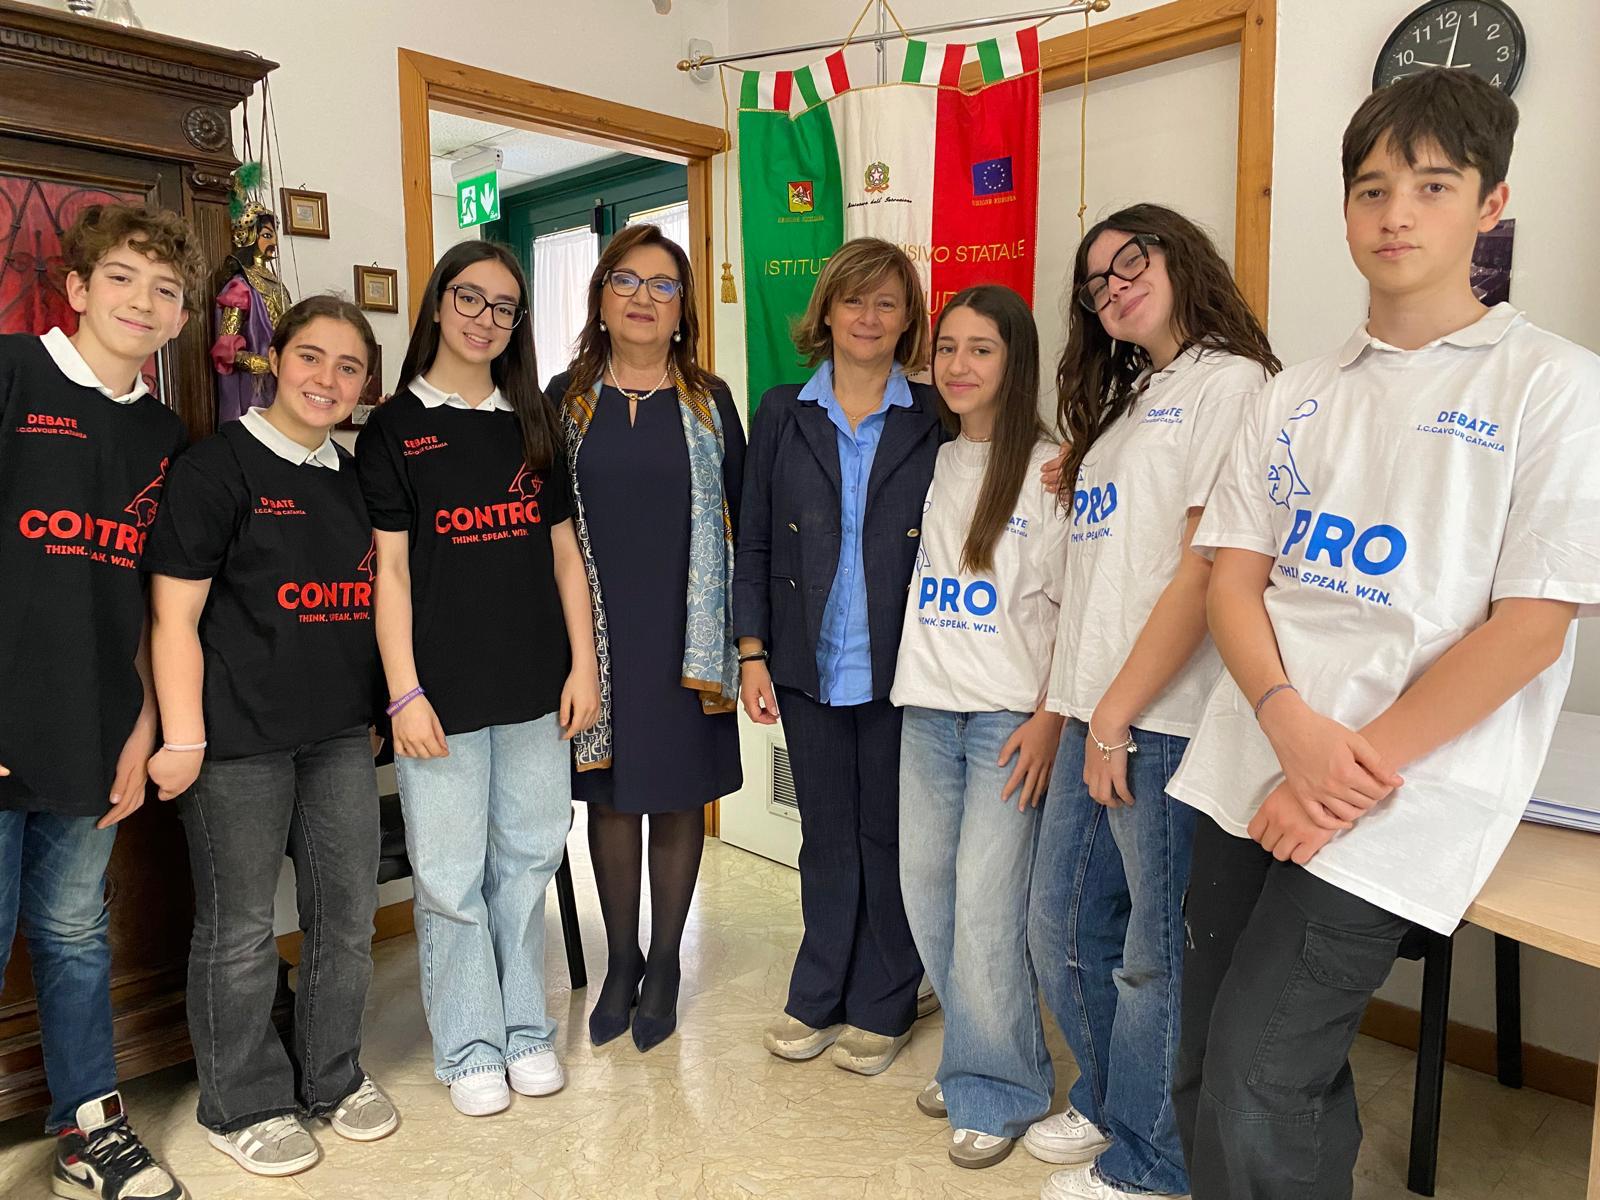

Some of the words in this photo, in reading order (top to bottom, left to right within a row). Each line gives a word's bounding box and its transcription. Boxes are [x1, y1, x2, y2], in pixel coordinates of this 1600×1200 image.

[1436, 11, 1458, 30] 12
[1469, 11, 1478, 27] 1
[1412, 25, 1431, 43] 11
[1487, 23, 1500, 40] 2
[1394, 49, 1415, 66] 10
[1497, 46, 1510, 62] 3
[1489, 73, 1502, 88] 4
[764, 257, 831, 276] ISTITU
[955, 239, 1025, 262] STATALE
[26, 413, 78, 429] DEBATE
[1437, 411, 1499, 436] DEBATE
[1465, 435, 1505, 452] CATANIA
[260, 496, 295, 508] DBATE
[1073, 482, 1118, 527] PRO
[19, 509, 147, 556] COTR
[482, 530, 511, 541] SPEAK.
[1282, 509, 1408, 576] PRO
[45, 544, 88, 556] THINK.
[111, 555, 136, 569] WIN.
[277, 582, 373, 610] CONTR
[919, 577, 997, 616] PRO
[1301, 572, 1349, 594] SPEAK.
[1355, 584, 1392, 607] WIN.
[940, 619, 970, 630] SPEAK.
[973, 622, 999, 634] WIN.
